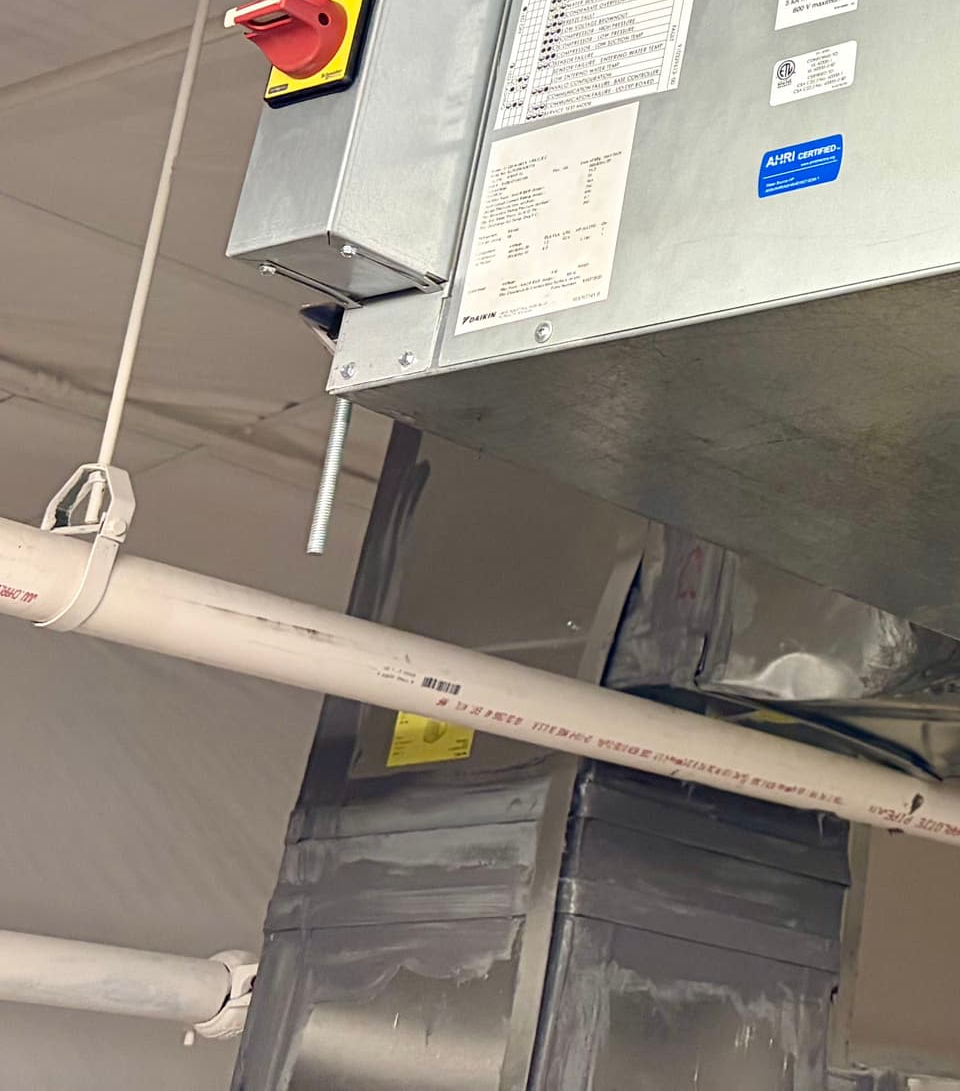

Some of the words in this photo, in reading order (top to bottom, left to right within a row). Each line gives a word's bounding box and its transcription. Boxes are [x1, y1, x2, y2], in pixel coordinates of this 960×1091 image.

[766, 151, 795, 168] AHRI
[798, 145, 836, 160] CERTIFIED
[469, 311, 496, 324] DAIKIN
